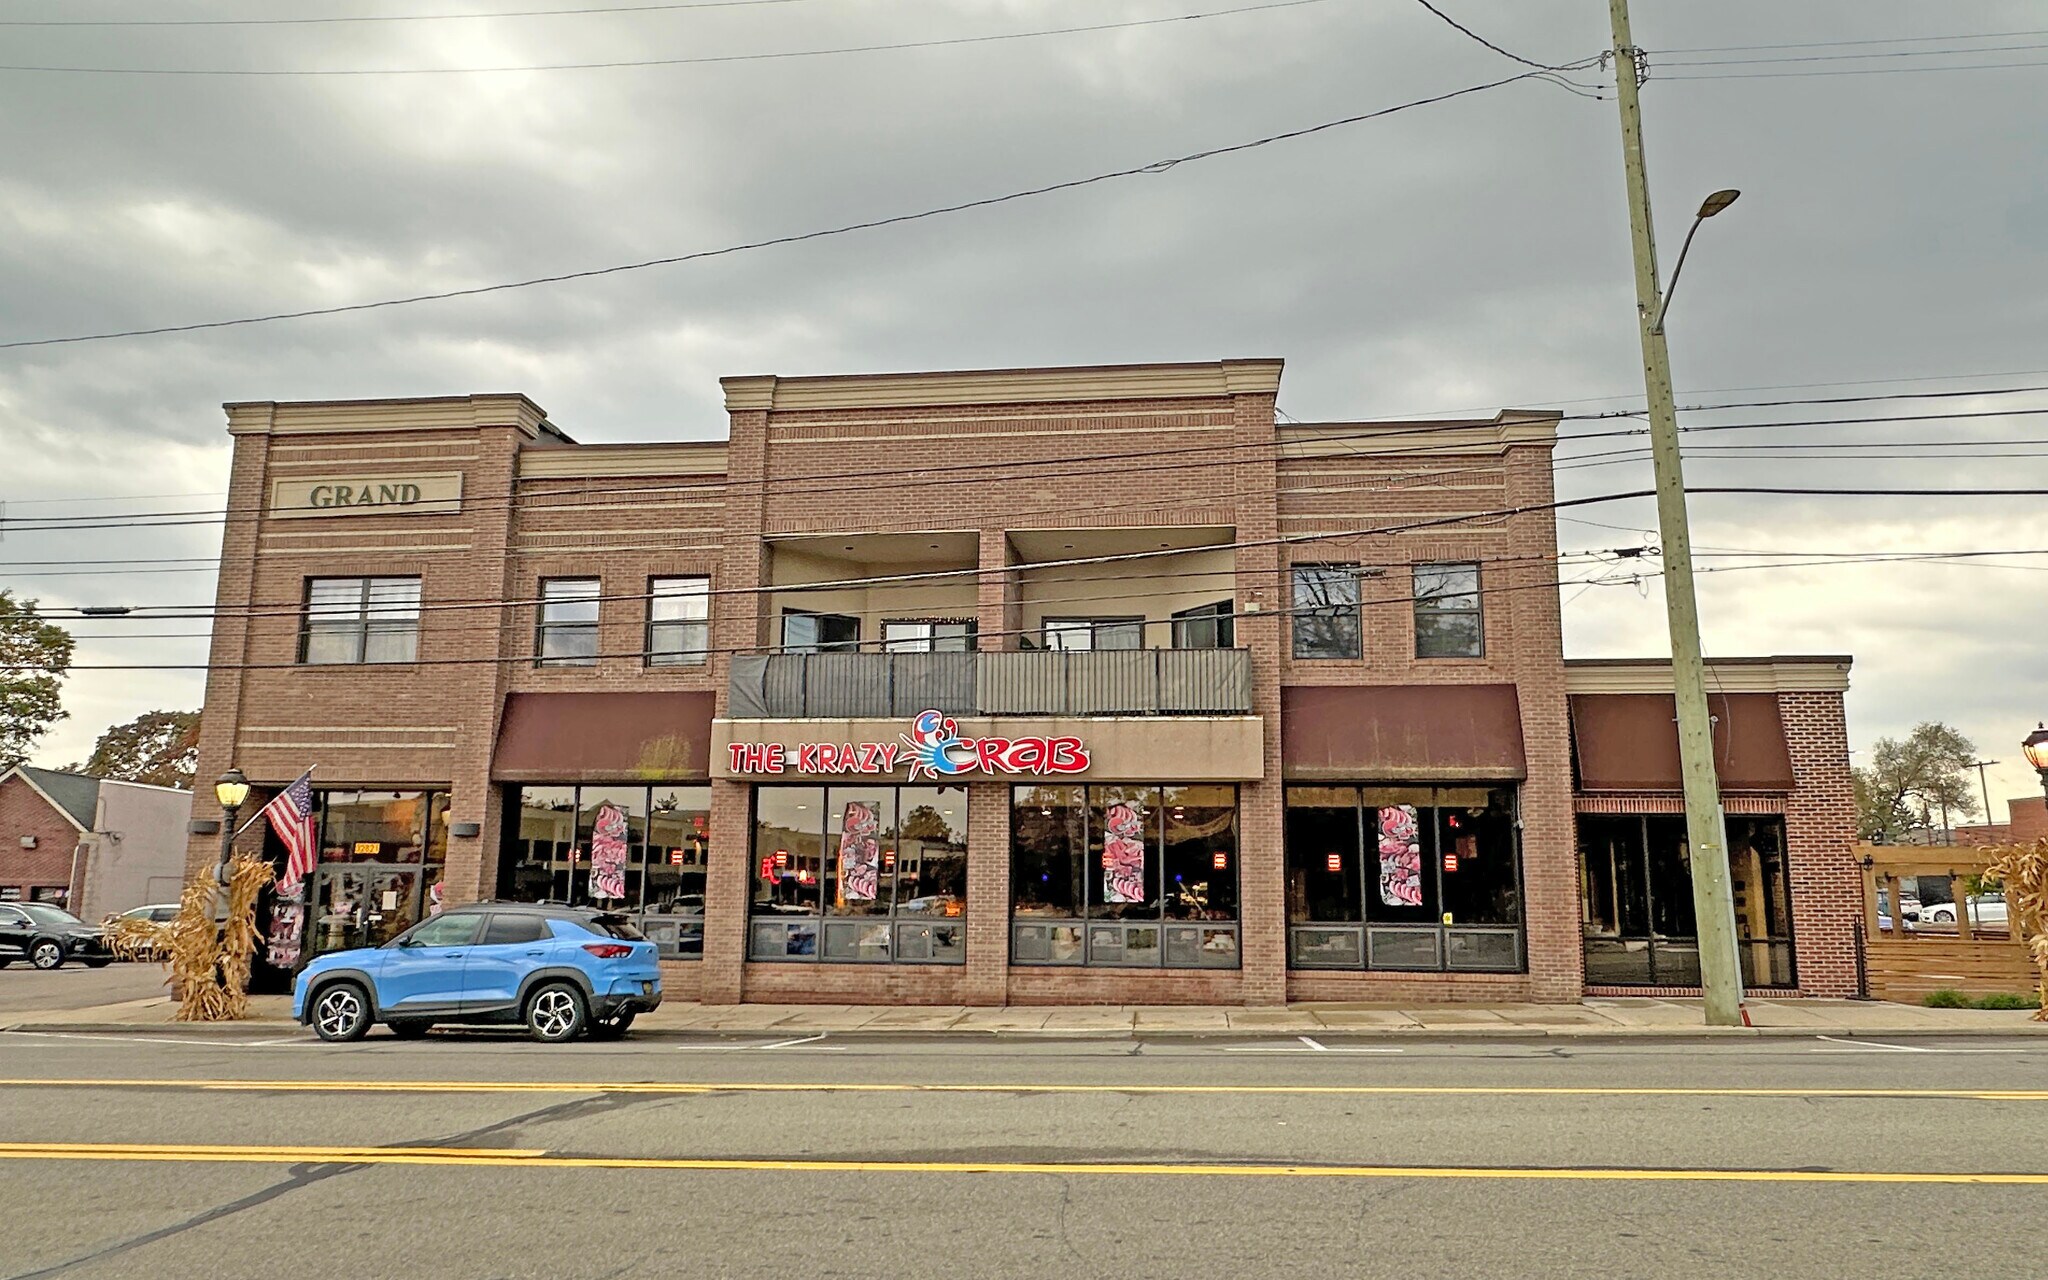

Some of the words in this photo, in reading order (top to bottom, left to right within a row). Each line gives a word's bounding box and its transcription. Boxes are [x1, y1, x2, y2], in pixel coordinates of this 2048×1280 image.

[310, 484, 421, 507] GRAND
[728, 742, 785, 773] THE
[798, 742, 898, 773] KRAZY
